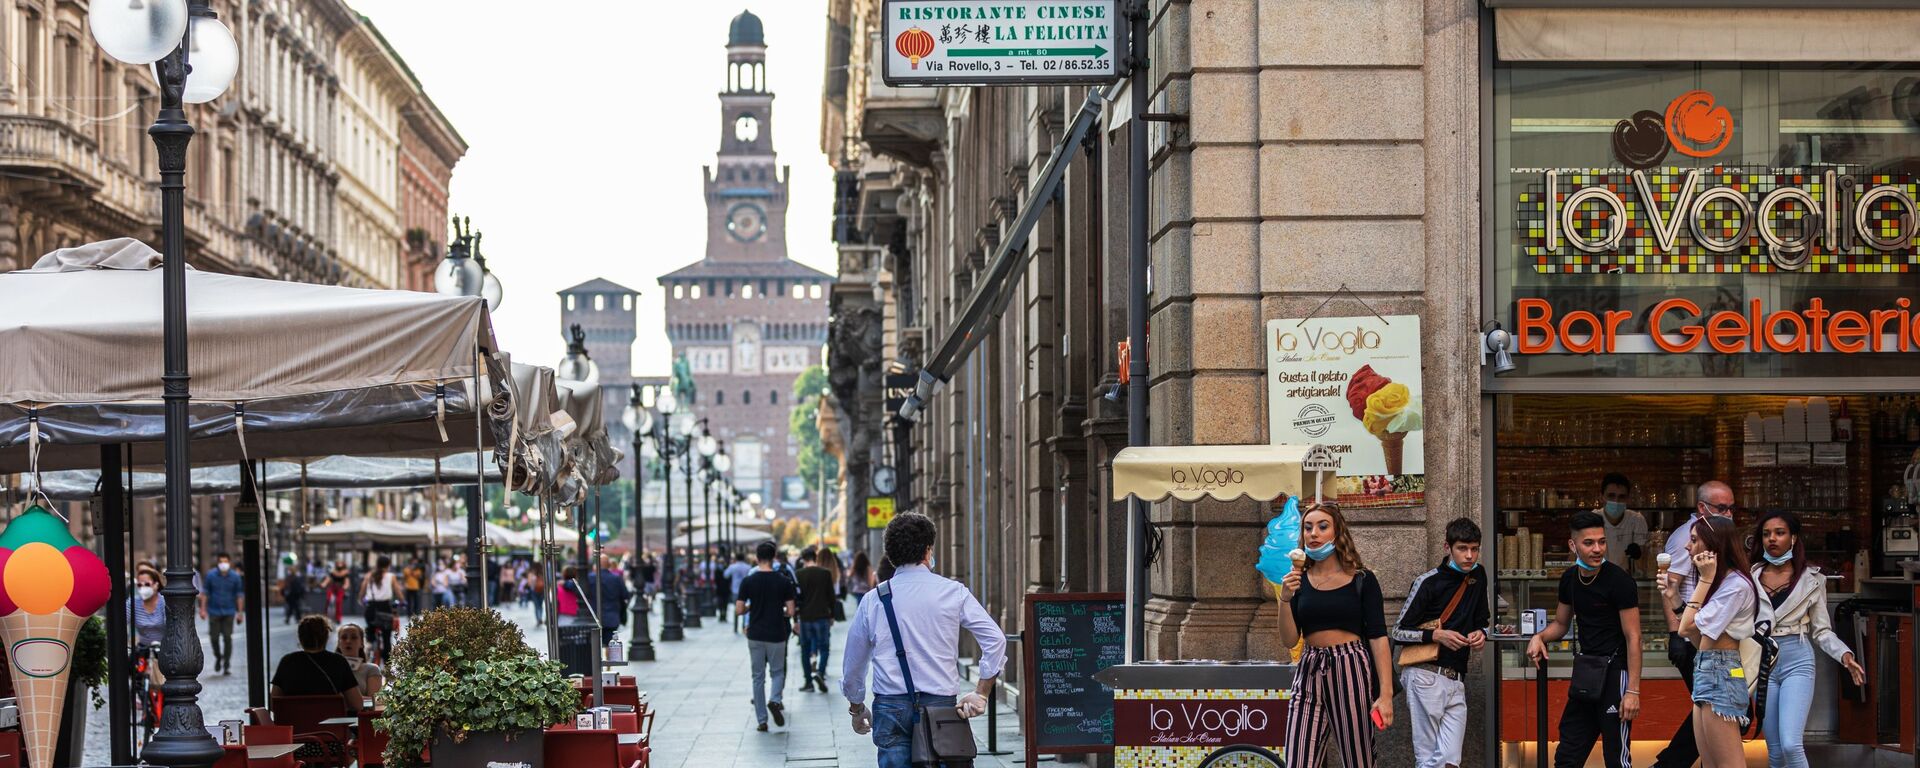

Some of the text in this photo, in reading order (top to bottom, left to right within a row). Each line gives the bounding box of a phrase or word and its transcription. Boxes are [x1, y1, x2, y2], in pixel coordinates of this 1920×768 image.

[899, 5, 1105, 20] RISTORANTE CINESE
[939, 23, 991, 44] 萬珍樓
[995, 25, 1109, 41] LA FELICITA'
[925, 60, 943, 71] Via
[1020, 60, 1038, 70] Tel.
[1517, 298, 1633, 354] Bar
[1648, 297, 1920, 355] Gelateri
[1276, 326, 1381, 354] la Voglia
[1279, 371, 1348, 386] Gusta il gelato
[1286, 387, 1341, 399] artigianale!
[1293, 416, 1336, 427] PREMIUM QUALITY
[1171, 466, 1244, 487] la Voglia
[1150, 703, 1268, 737] la Voglia
[1150, 731, 1180, 743] Italian
[1196, 731, 1222, 743] Cream
